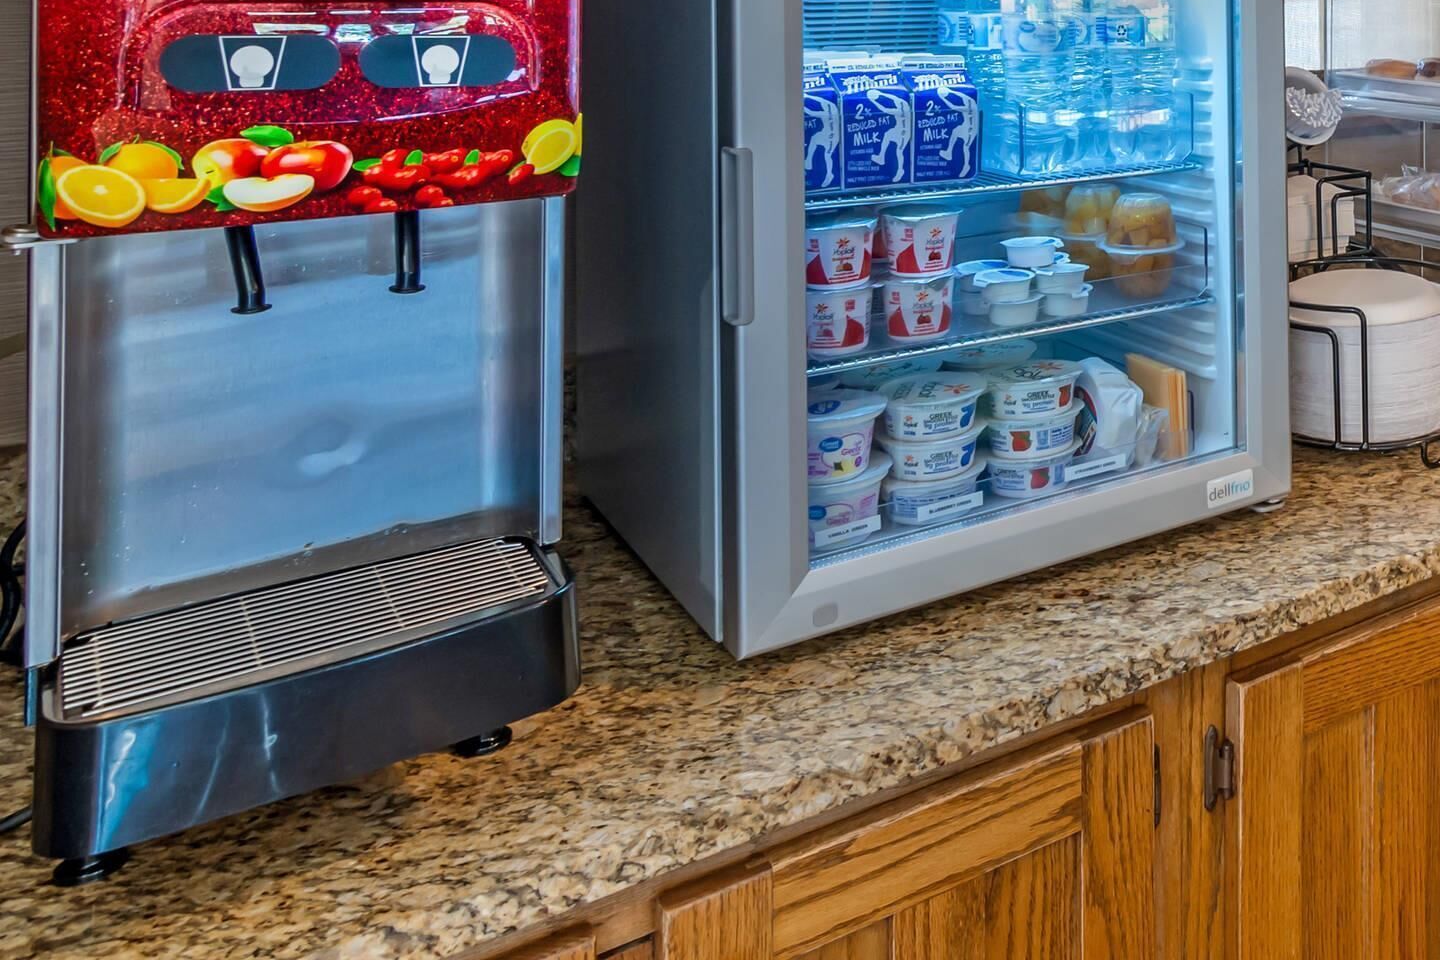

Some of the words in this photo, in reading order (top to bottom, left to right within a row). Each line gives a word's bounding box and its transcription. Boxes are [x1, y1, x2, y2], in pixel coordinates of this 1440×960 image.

[847, 119, 877, 132] REDUCED
[878, 115, 891, 127] FAT
[917, 116, 945, 128] REDUCED
[947, 114, 958, 123] FAT
[853, 131, 881, 146] MILK
[923, 128, 949, 142] MILK
[1209, 480, 1250, 502] dellfrio
